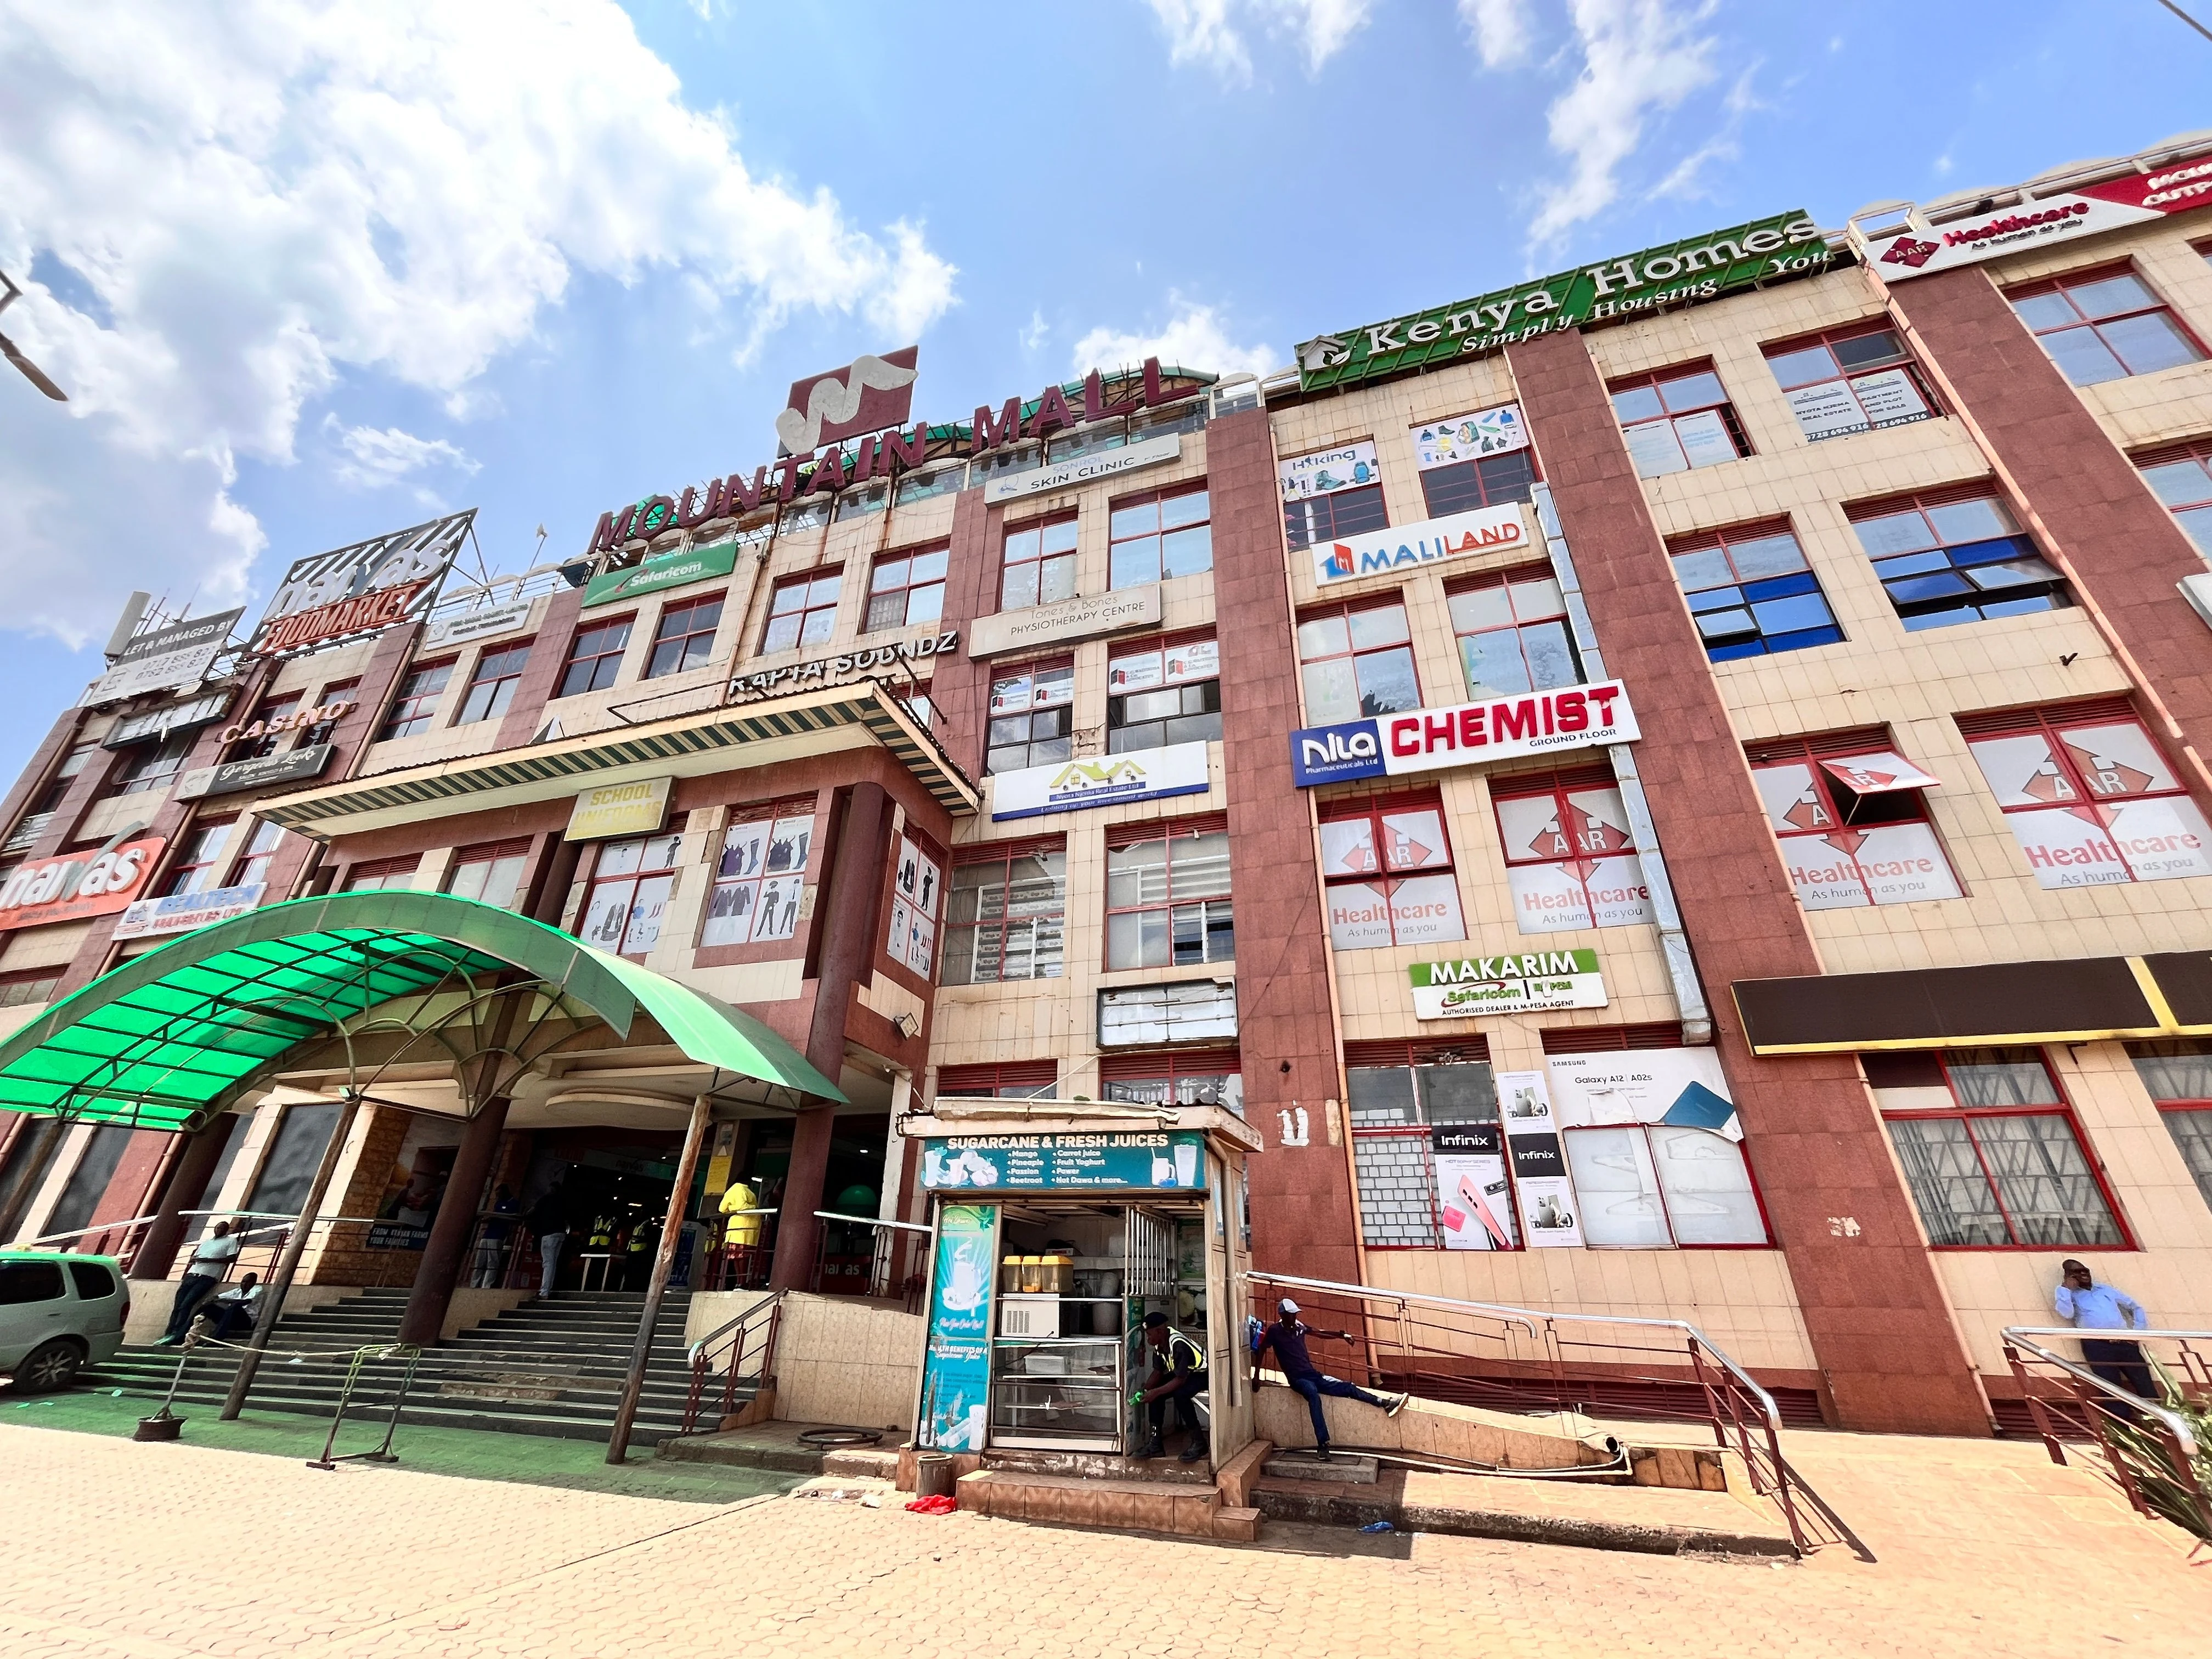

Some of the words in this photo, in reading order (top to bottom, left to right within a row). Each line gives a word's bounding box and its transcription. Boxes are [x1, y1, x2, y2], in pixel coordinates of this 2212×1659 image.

[1943, 202, 2089, 247] Healthcare
[1989, 229, 2036, 246] human
[2039, 225, 2055, 235] as
[2058, 218, 2083, 233] you
[1896, 244, 1928, 258] AAR
[1363, 289, 1560, 358] Kenya
[1587, 217, 1822, 299] Homes
[1462, 311, 1576, 354] Simply
[1592, 276, 1719, 321] Housing
[1768, 249, 1831, 276] You
[1802, 413, 1822, 421] REAL
[1824, 408, 1852, 416] ESTATE
[586, 420, 928, 554] MOUNTAIN
[970, 356, 1200, 454] MALL
[1053, 455, 1103, 474] SONROL
[1030, 472, 1070, 489] SKIN
[1077, 456, 1135, 477] CLINIC
[1361, 522, 1521, 574] MALILAND
[629, 561, 702, 587] Safaricom
[1081, 594, 1118, 610] Bones
[260, 585, 419, 651] FOODMARKET
[1010, 610, 1097, 636] PHYSIOTHERAPY
[1103, 601, 1146, 618] CENTRE
[124, 642, 146, 656] LET
[155, 624, 215, 647] MANAGED
[216, 619, 235, 632] BY
[836, 630, 958, 674] SOUNDZ
[220, 699, 350, 744] CASINO
[1391, 685, 1620, 758] CHEMIST
[1530, 735, 1577, 747] GROUND
[1579, 728, 1617, 740] FLOOR
[1305, 761, 1364, 774] Pharmaceuticals
[1366, 758, 1378, 766] Ltd
[590, 783, 653, 806] SCHOOL
[1108, 785, 1128, 793] Estate
[2061, 872, 2079, 885] As
[2143, 861, 2159, 873] as
[2163, 857, 2194, 874] you
[1811, 888, 1827, 900] As
[1880, 882, 1896, 894] as
[1899, 879, 1926, 896] you
[1542, 913, 1556, 924] As
[1604, 909, 1617, 919] as
[1619, 906, 1643, 919] you
[1347, 926, 1360, 937] As
[1402, 924, 1414, 934] as
[1416, 923, 1437, 935] you
[1430, 951, 1579, 985] MAKARIM
[1447, 988, 1521, 1003] Safaricom
[1442, 1006, 1484, 1015] AUTHORISED
[1520, 1002, 1547, 1010] M-PESA
[1575, 1076, 1607, 1085] Galaxy
[1610, 1075, 1624, 1083] A12
[1631, 1074, 1653, 1082] A02s
[947, 1136, 1040, 1149] SUGARCANE
[1041, 1136, 1053, 1148] &
[1056, 1135, 1108, 1148] FRESH
[1109, 1133, 1169, 1147] JUICES
[1441, 1134, 1489, 1146] Infinix
[1011, 1150, 1038, 1159] Mango
[1075, 1158, 1105, 1167] Yoghurt
[1082, 1149, 1101, 1158] juice
[1517, 1150, 1555, 1160] Infinix
[369, 1236, 385, 1245] YOUR
[384, 1237, 410, 1246] FAMILIES
[373, 1228, 389, 1236] FROM
[410, 1229, 430, 1239] FARMS
